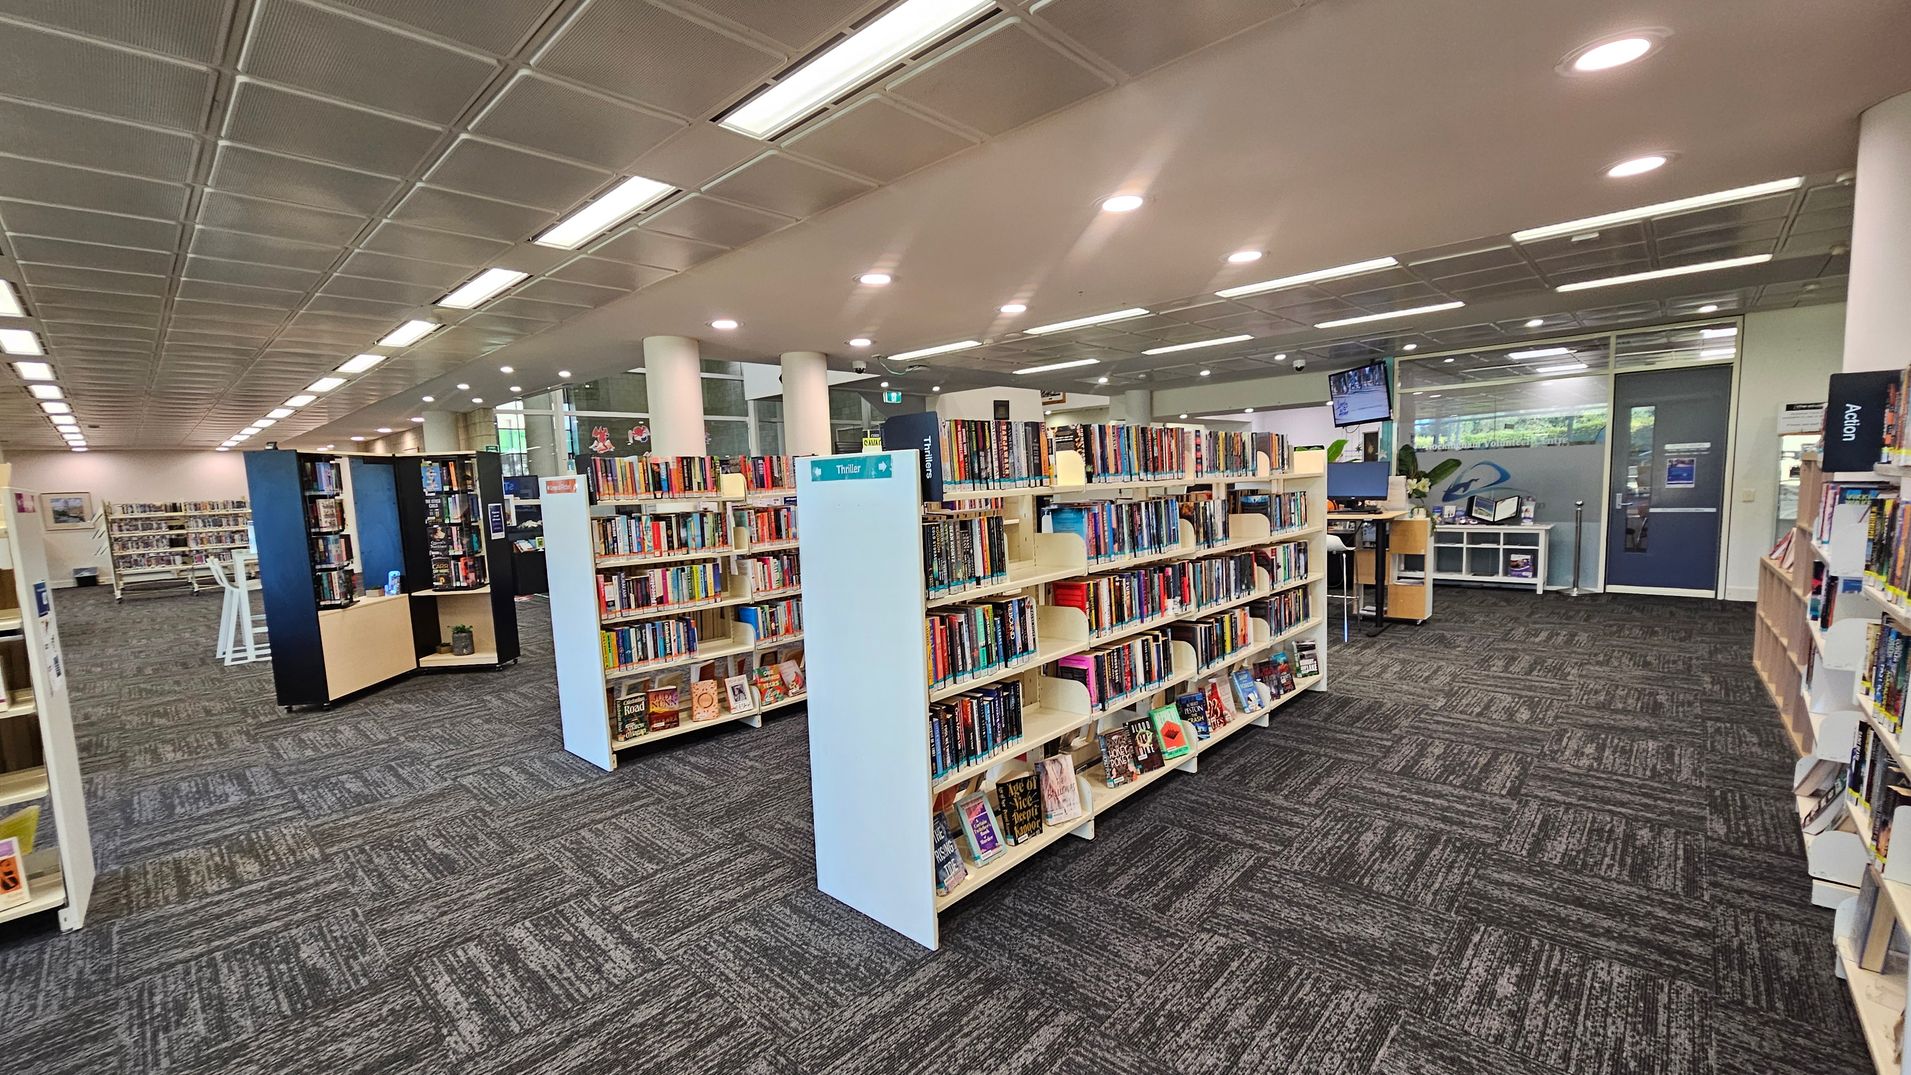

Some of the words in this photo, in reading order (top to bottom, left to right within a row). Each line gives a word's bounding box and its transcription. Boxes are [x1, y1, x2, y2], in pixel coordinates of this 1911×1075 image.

[1843, 404, 1861, 441] Action
[924, 435, 934, 479] Thrillers
[836, 464, 861, 474] Thriller
[624, 701, 645, 716] Road
[652, 699, 677, 709] NUNN
[1008, 782, 1024, 797] Age
[1026, 776, 1038, 790] of
[1013, 795, 1033, 810] Vice
[1012, 805, 1039, 825] Deepti
[933, 826, 945, 843] THE
[934, 840, 955, 863] RISING
[943, 858, 958, 876] TIDE
